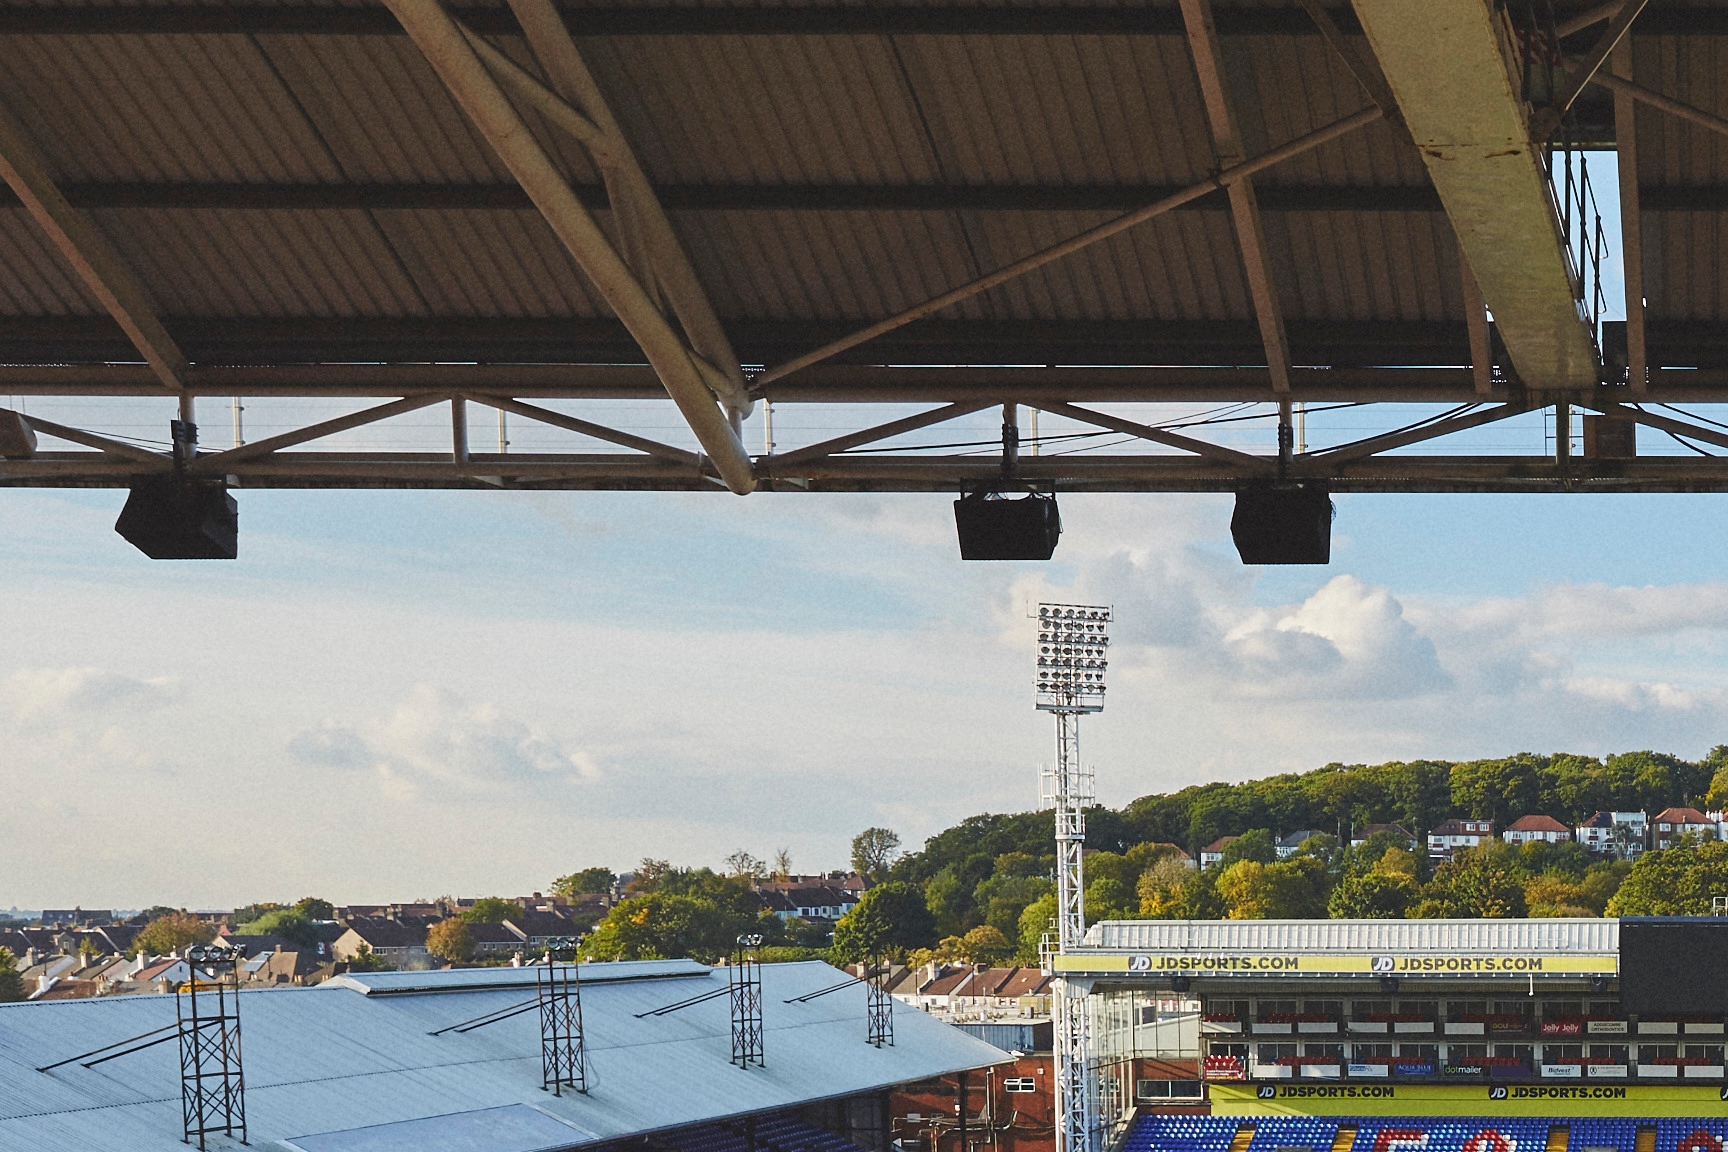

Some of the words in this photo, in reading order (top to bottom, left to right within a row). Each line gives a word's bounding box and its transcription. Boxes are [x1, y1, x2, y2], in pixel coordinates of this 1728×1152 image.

[1156, 956, 1299, 970] JDSPORTS.COM
[1400, 957, 1543, 971] JDSPORTS.COM
[1542, 1023, 1560, 1034] Jelly
[1561, 1023, 1579, 1034] Jelly
[1445, 1065, 1482, 1074] dotmailer
[1548, 1066, 1571, 1074] Bidvest
[1279, 1086, 1395, 1098] JDSPORTS.COM
[1511, 1087, 1626, 1099] JDSPORTS.COM
